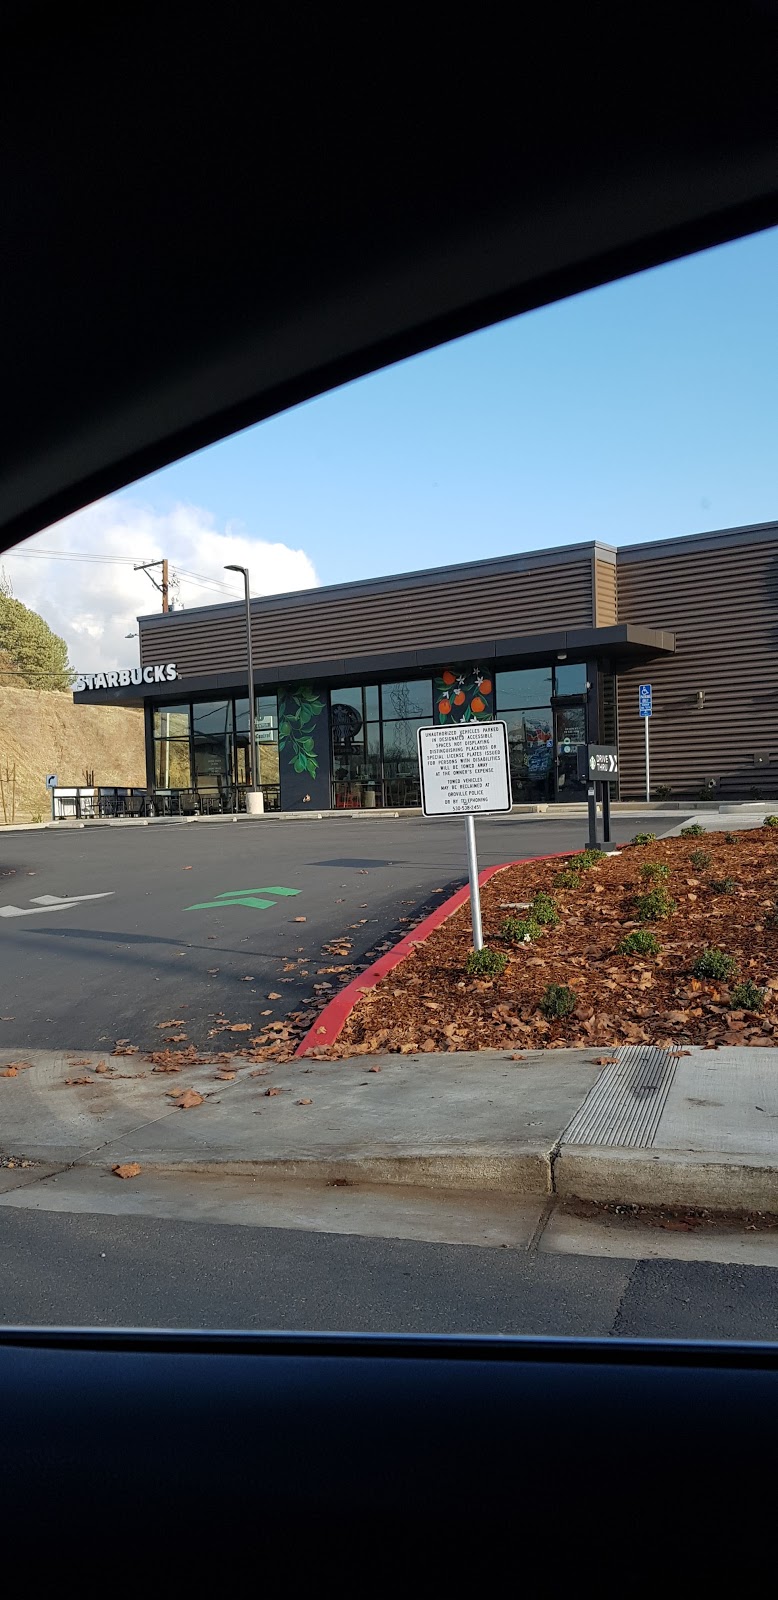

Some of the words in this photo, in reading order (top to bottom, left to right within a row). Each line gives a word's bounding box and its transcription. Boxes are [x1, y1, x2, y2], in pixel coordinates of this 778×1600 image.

[73, 663, 178, 692] STARBUCKS
[425, 730, 457, 738] UNAUTHORIZED
[596, 754, 609, 764] DRIVE
[596, 763, 608, 772] THRU
[447, 790, 468, 798] OROVILLE
